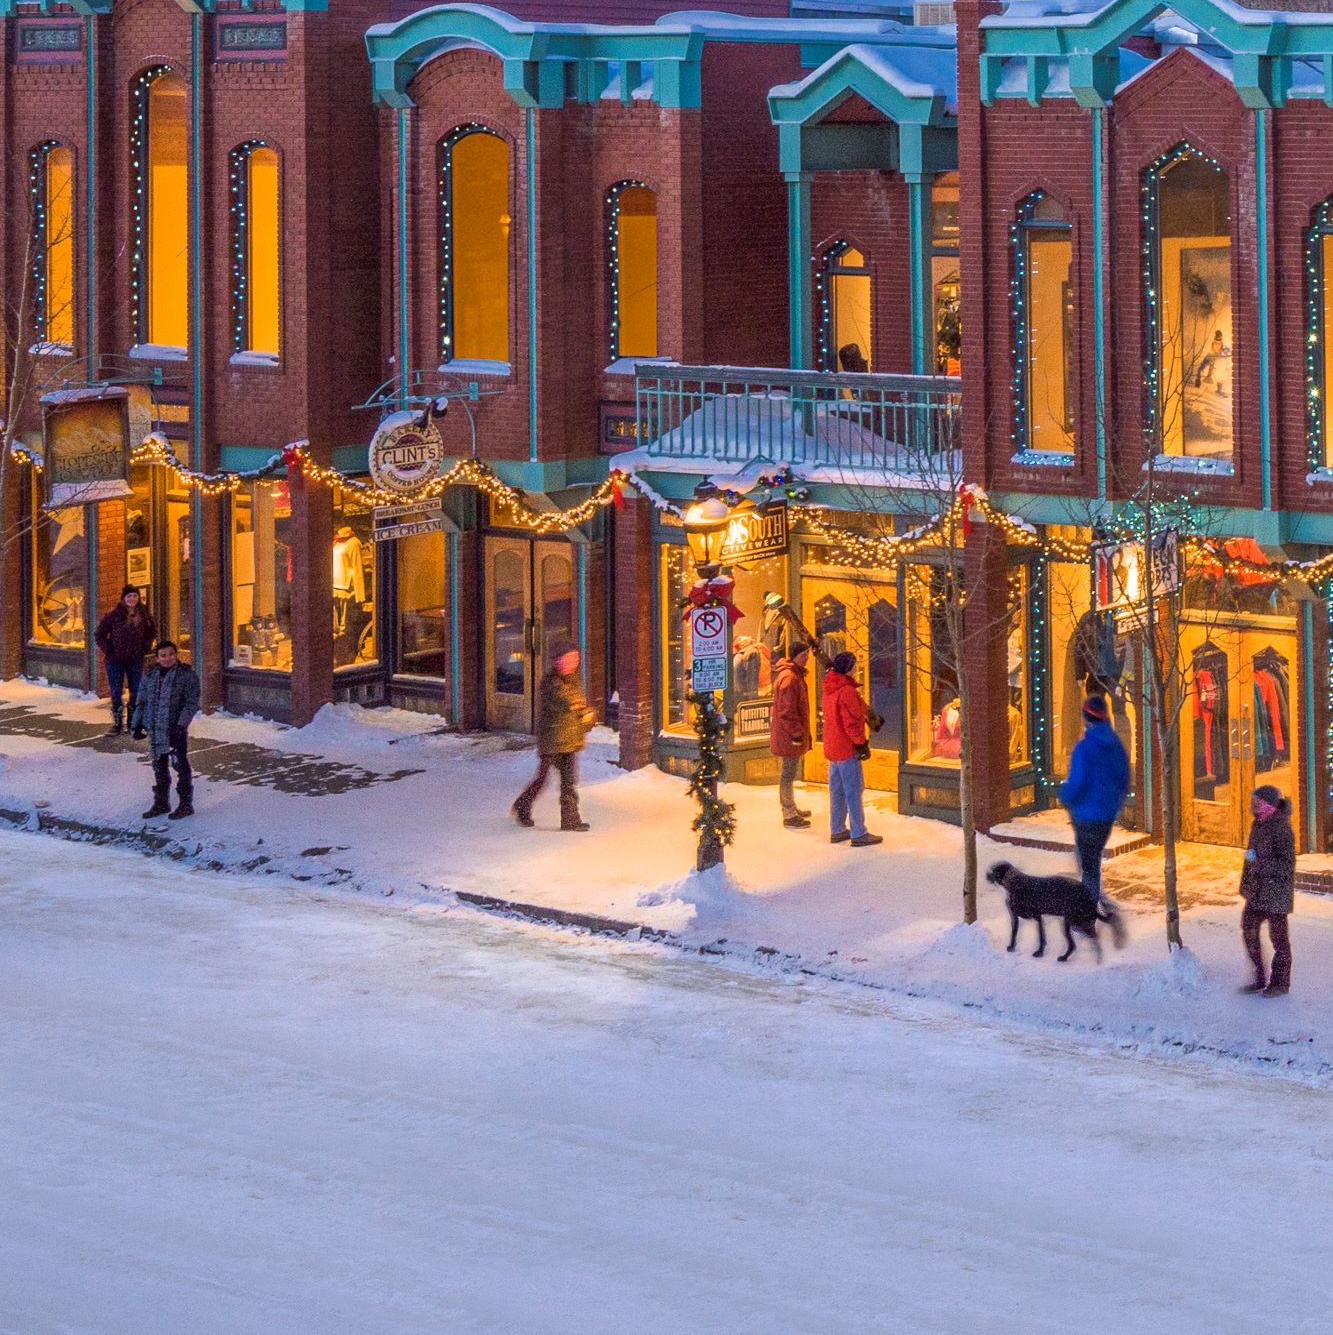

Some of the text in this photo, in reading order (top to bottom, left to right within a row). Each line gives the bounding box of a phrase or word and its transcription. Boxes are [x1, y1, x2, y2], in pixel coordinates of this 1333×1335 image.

[376, 521, 442, 540] ICE CREAM
[721, 537, 784, 554] CTIVEWEAR
[694, 659, 702, 672] 3
